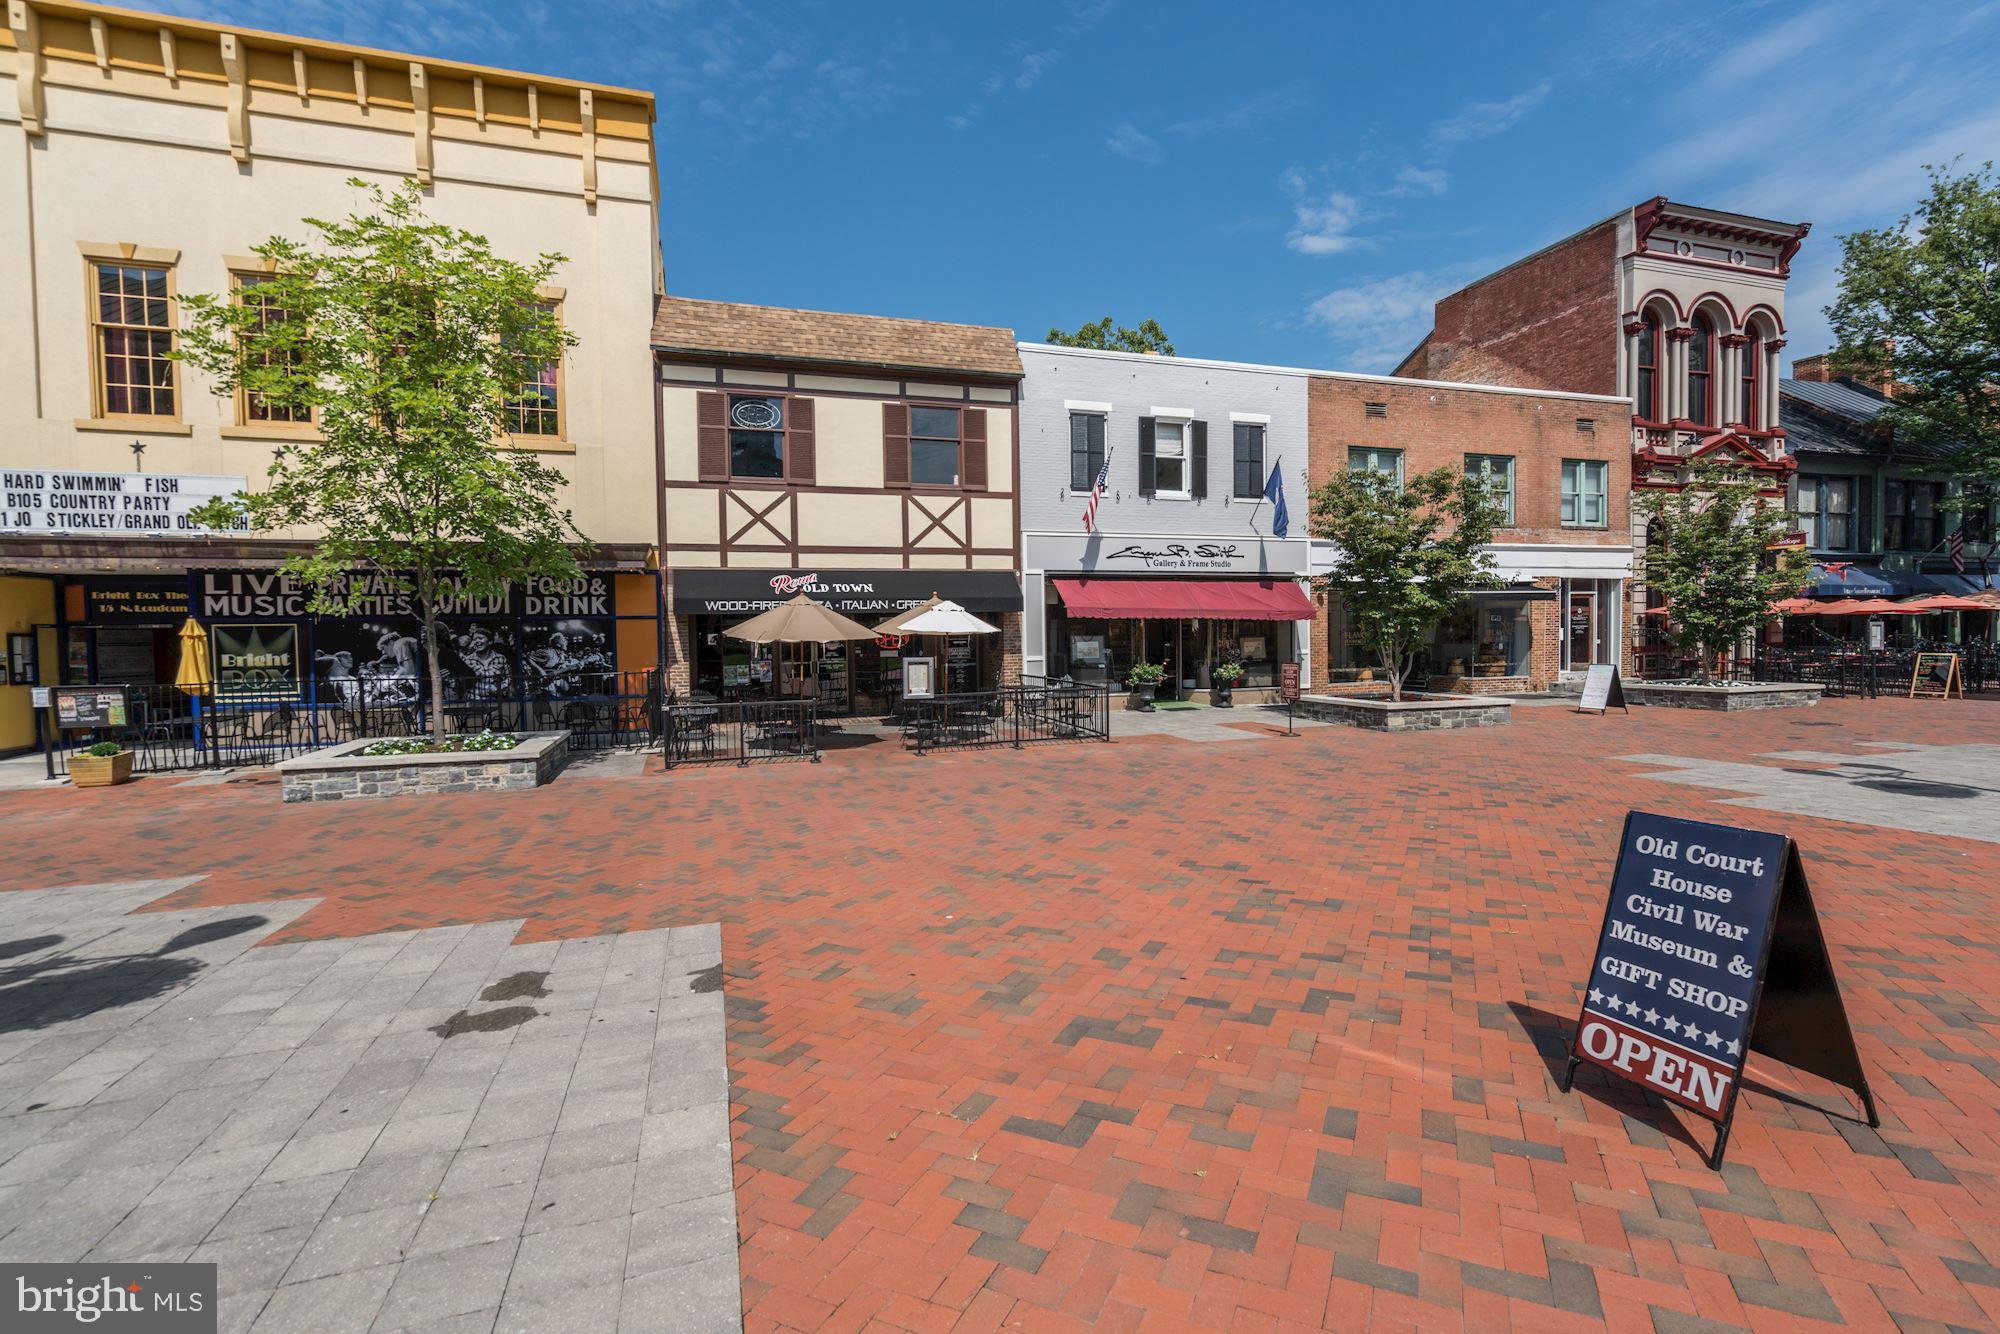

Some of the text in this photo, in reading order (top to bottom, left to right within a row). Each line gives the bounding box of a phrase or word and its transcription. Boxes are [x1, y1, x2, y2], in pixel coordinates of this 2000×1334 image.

[4, 474, 44, 489] HARD
[145, 478, 179, 493] FISH
[7, 493, 170, 511] B105 COUNTRY PARTY
[1106, 546, 1162, 567] Eugene
[1194, 545, 1244, 558] Smith
[1153, 560, 1178, 569] Gallery
[1211, 560, 1231, 568] Studio
[205, 574, 304, 594] LIVE
[769, 573, 818, 595] Roma
[803, 583, 874, 593] OLD TOWN
[91, 591, 130, 600] Bright
[136, 592, 159, 600] Box
[205, 595, 305, 616] MUSIC
[525, 596, 609, 615] DRINK
[705, 600, 784, 611] WOOD-FIRE
[841, 600, 889, 610] ITALIAN
[221, 653, 291, 668] Bright
[221, 669, 291, 690] BOX
[1635, 834, 1764, 877] Old Court
[1650, 868, 1733, 903] House
[1626, 894, 1750, 942] Civil War
[1609, 920, 1753, 979] Museum &
[1600, 956, 1748, 1018] GIFT SHOP
[1581, 1022, 1732, 1112] OPEN
